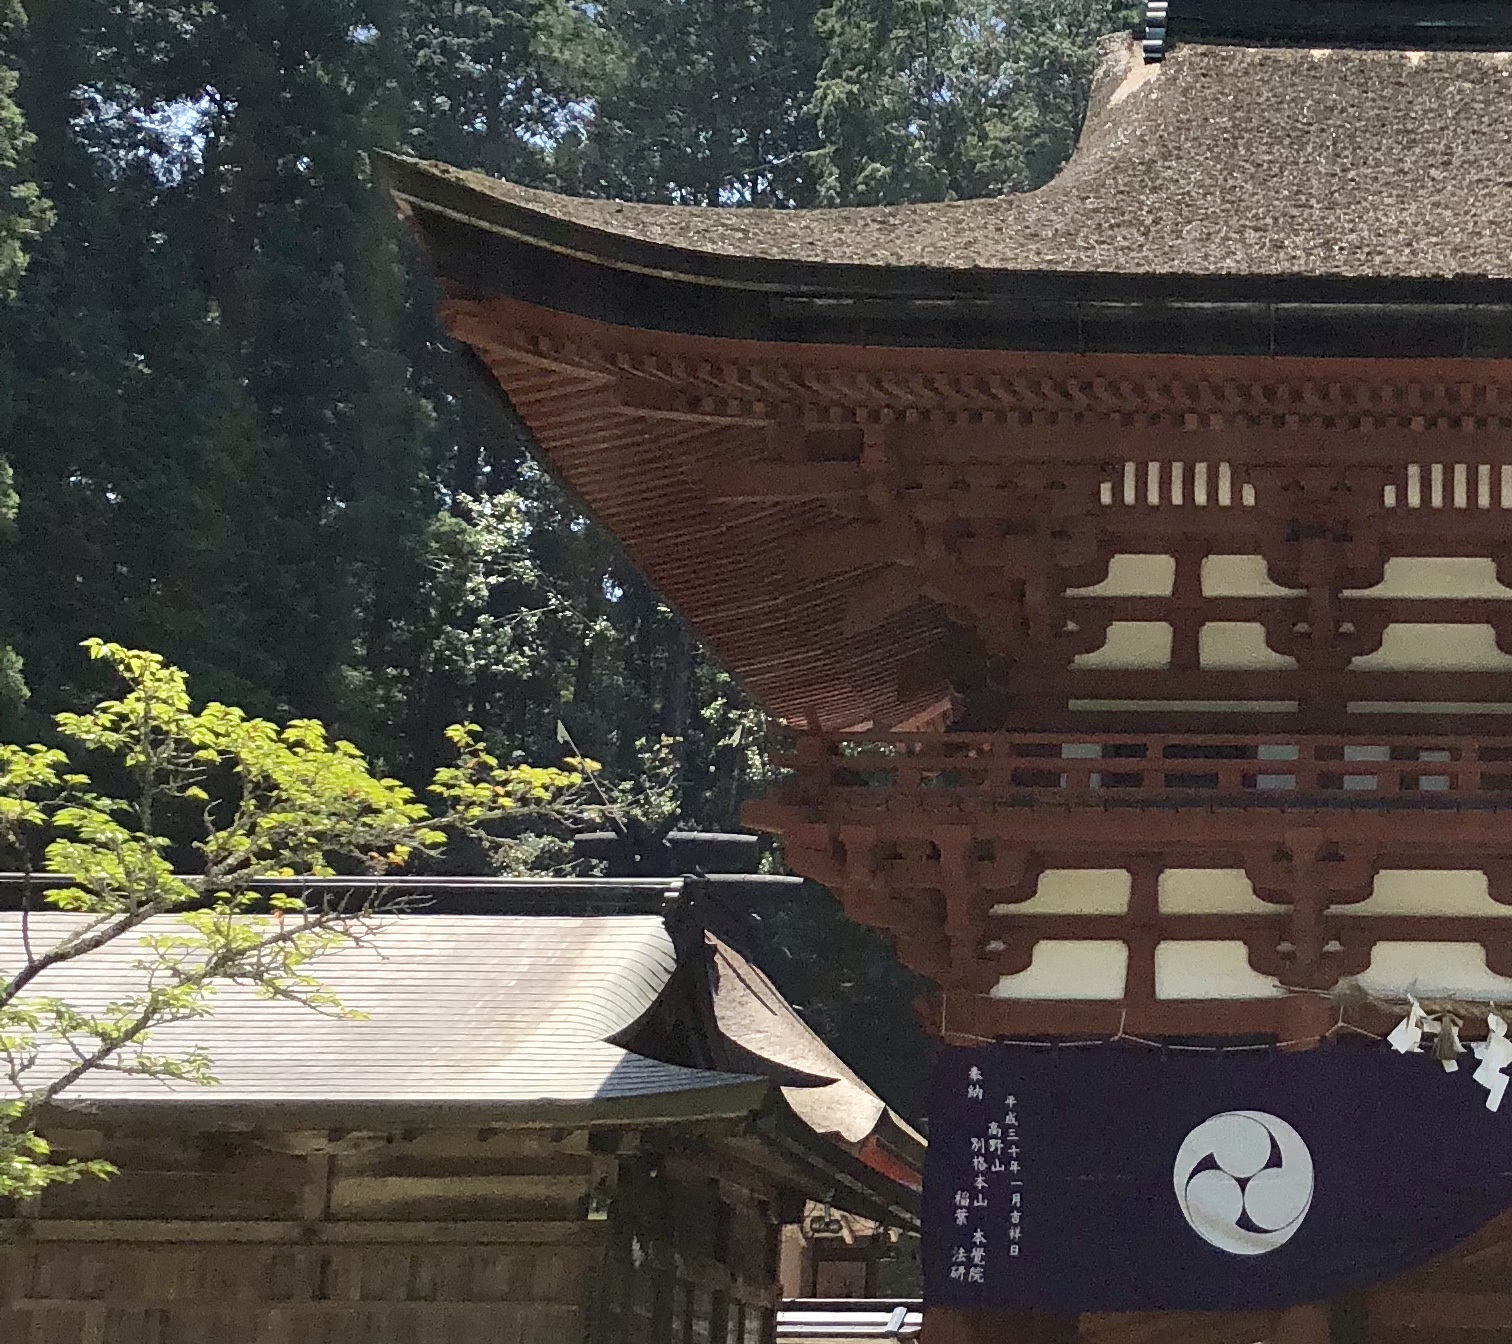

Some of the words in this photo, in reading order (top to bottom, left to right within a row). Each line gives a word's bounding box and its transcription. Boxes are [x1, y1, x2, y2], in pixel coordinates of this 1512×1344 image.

[967, 1065, 983, 1100] 奉納
[971, 1137, 989, 1208] 別格本山
[988, 1121, 1005, 1173] 高野山
[1004, 1095, 1024, 1256] 平成三十年一月吉祥日
